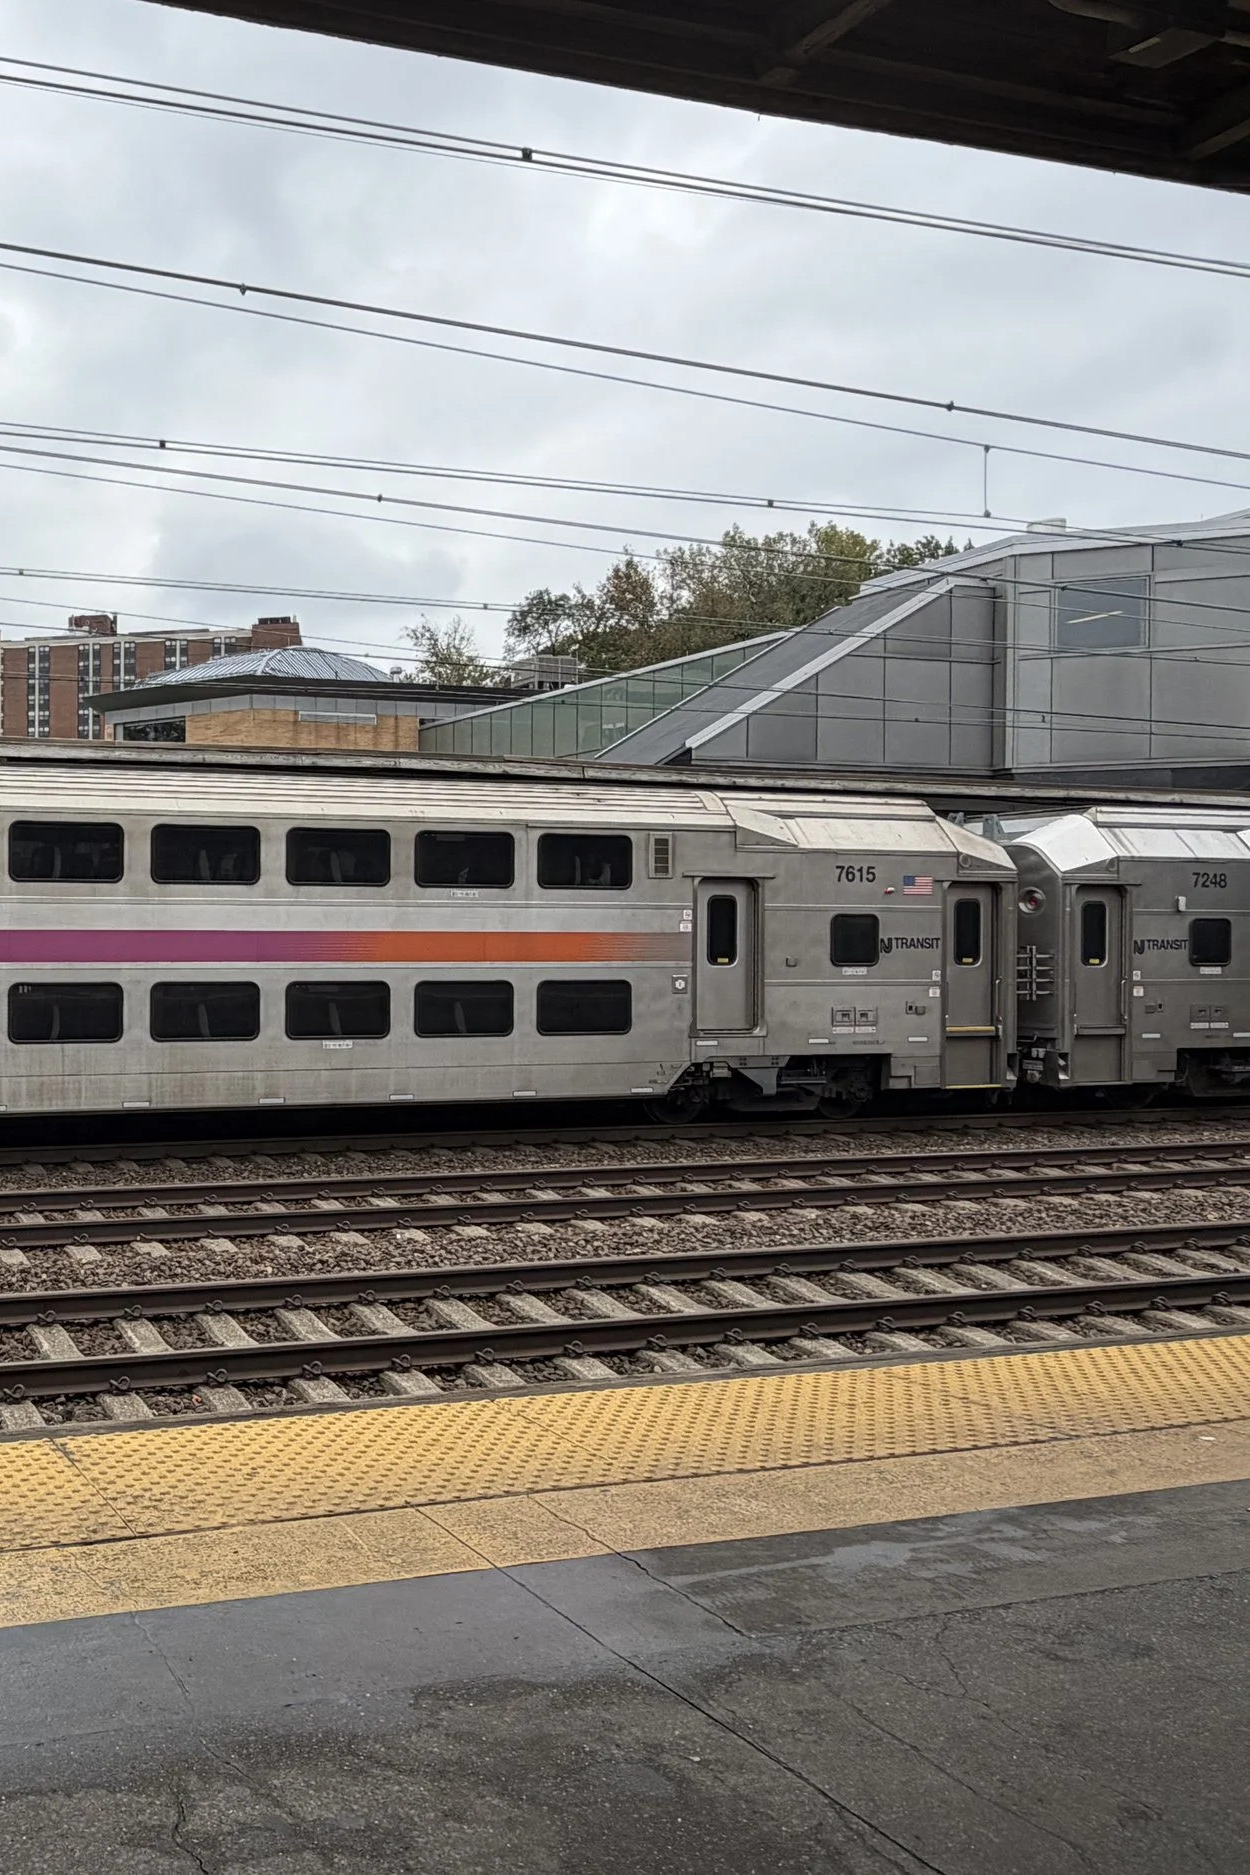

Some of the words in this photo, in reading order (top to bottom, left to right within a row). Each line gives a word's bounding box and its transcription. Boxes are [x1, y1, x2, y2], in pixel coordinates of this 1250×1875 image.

[835, 865, 877, 883] 7615
[1192, 872, 1228, 889] 7248
[894, 937, 941, 950] TRANSIT
[1146, 939, 1189, 951] TRANSIT
